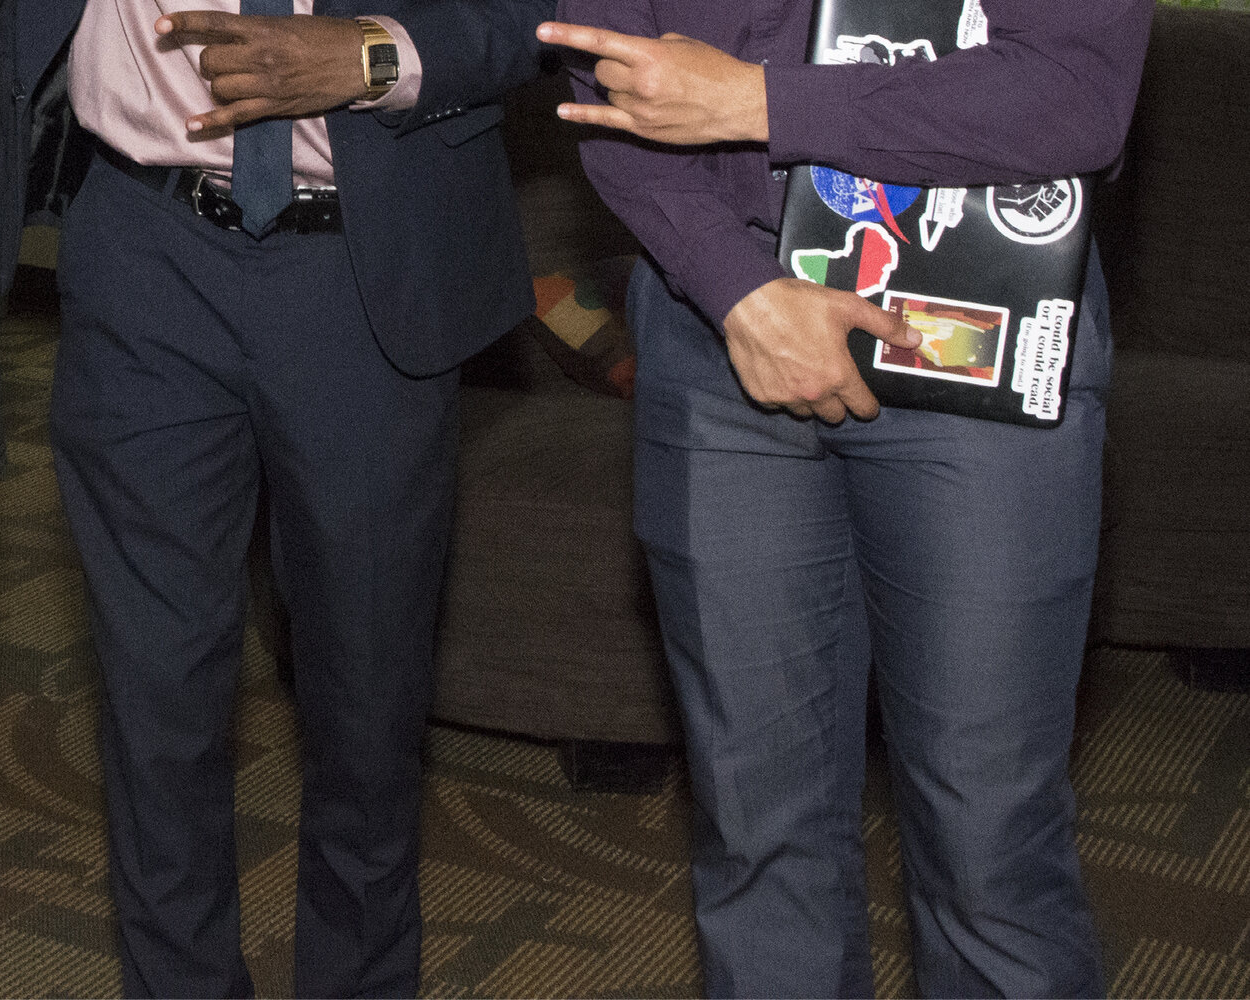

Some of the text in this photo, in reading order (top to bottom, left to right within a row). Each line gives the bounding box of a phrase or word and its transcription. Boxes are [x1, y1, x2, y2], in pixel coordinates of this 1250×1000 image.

[852, 177, 878, 215] SA
[1042, 305, 1050, 321] or
[1051, 315, 1063, 352] could
[1034, 335, 1046, 373] could
[1048, 356, 1059, 370] be
[1028, 377, 1040, 408] read.
[1042, 376, 1054, 415] social
